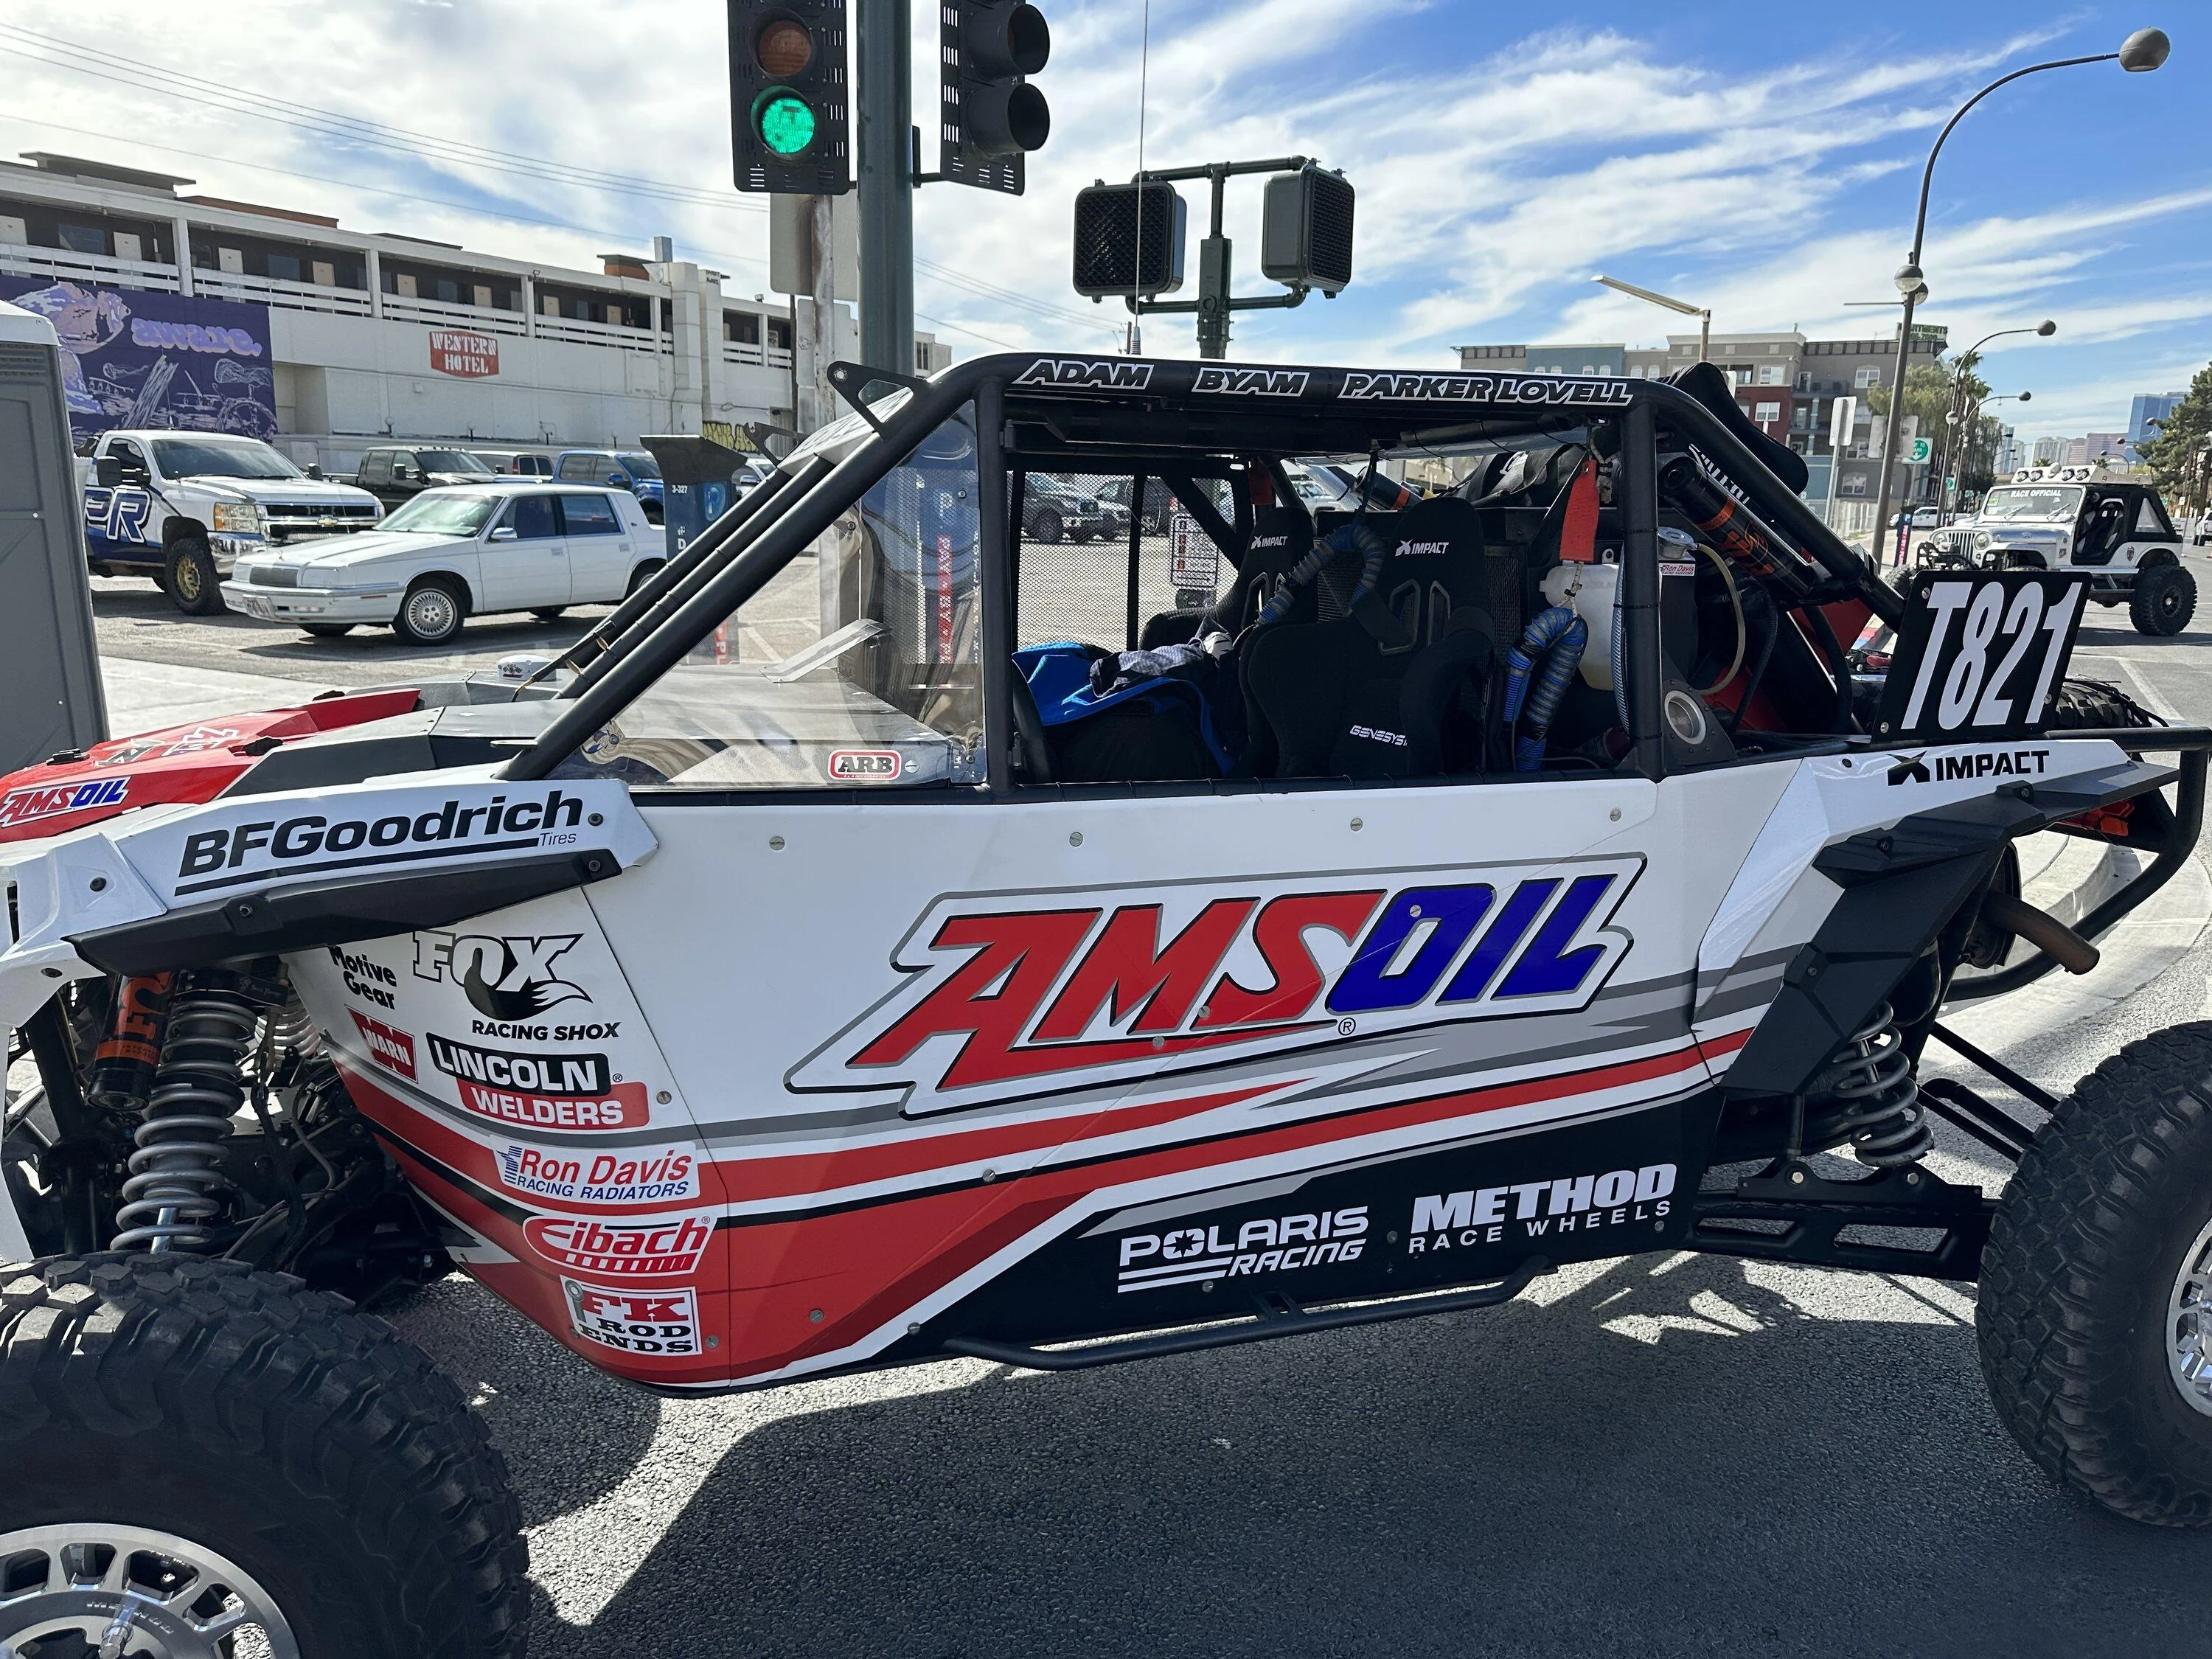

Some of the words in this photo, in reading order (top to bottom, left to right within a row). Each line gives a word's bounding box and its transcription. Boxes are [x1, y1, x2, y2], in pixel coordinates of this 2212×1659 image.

[431, 333, 497, 355] WESTERN
[445, 353, 489, 373] HOTEL
[1012, 359, 1154, 389] ADAM
[1192, 367, 1310, 397] BYAM
[1337, 373, 1494, 403] PARKER
[1495, 378, 1634, 406] LOVELL
[672, 484, 688, 494] 3-327
[1262, 535, 1288, 547] IMPACT
[1411, 541, 1450, 554] IMPACT
[1900, 581, 2083, 730] T821
[838, 757, 893, 773] ARB
[1935, 750, 2050, 782] IMPACT
[0, 779, 126, 825] AMSOIL
[179, 790, 583, 877] BFGoodrich
[539, 833, 577, 847] Tires
[329, 946, 397, 987] Motive
[413, 931, 587, 997] FOX
[344, 970, 395, 1010] Gear
[845, 874, 1621, 1093] AMSOIL
[362, 1026, 412, 1067] WARN
[472, 1020, 548, 1041] RACING
[554, 1022, 621, 1041] SHOX
[434, 1040, 598, 1091] LINCOLN
[470, 1087, 625, 1125] WELDERS
[519, 1149, 580, 1183] Ron
[588, 1150, 692, 1186] Davis
[517, 1176, 574, 1197] RACING
[580, 1181, 689, 1200] RADIATORS
[1411, 1164, 1677, 1234] METHOD
[524, 1217, 709, 1264] Eibach
[1119, 1206, 1368, 1266] POLARIS
[1408, 1225, 1503, 1253] RACE
[1526, 1200, 1672, 1237] WHEELS
[1227, 1239, 1366, 1277] RACING
[580, 1292, 689, 1322] FK
[579, 1324, 693, 1354] ENDS
[597, 1318, 692, 1338] ROD
